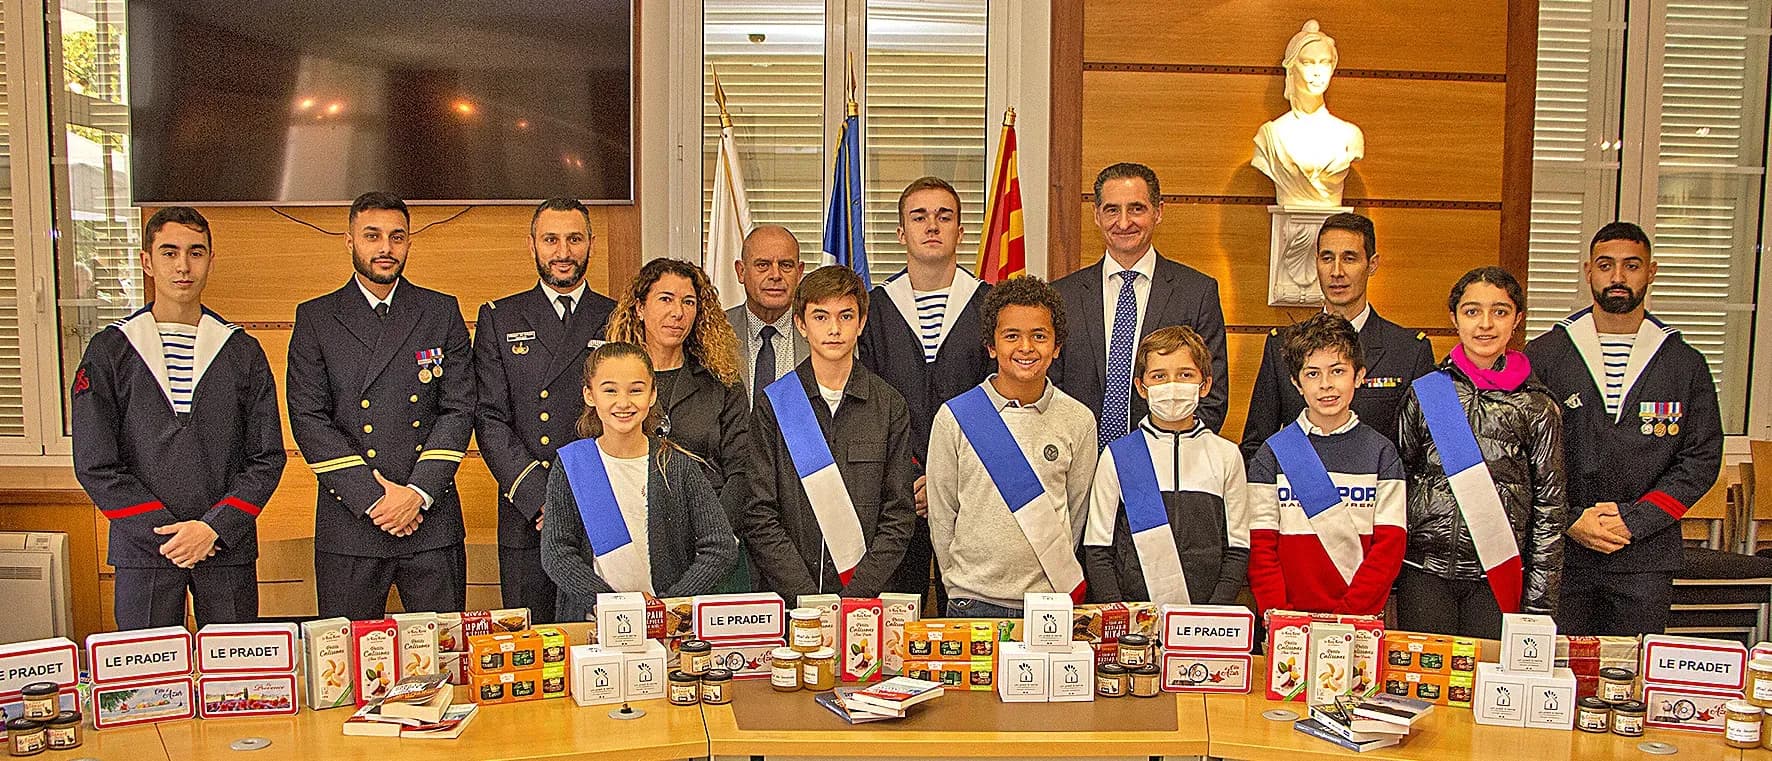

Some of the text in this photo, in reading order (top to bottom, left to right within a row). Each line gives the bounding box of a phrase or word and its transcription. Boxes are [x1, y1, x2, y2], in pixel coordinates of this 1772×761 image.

[1336, 486, 1376, 501] POR
[710, 614, 773, 626] LE PRADET
[1177, 626, 1241, 637] LE PRADET
[106, 651, 178, 668] LE PRADET
[211, 646, 280, 659] LE PRADET
[9, 662, 64, 680] PRADET
[1659, 658, 1732, 674] LE PRADET
